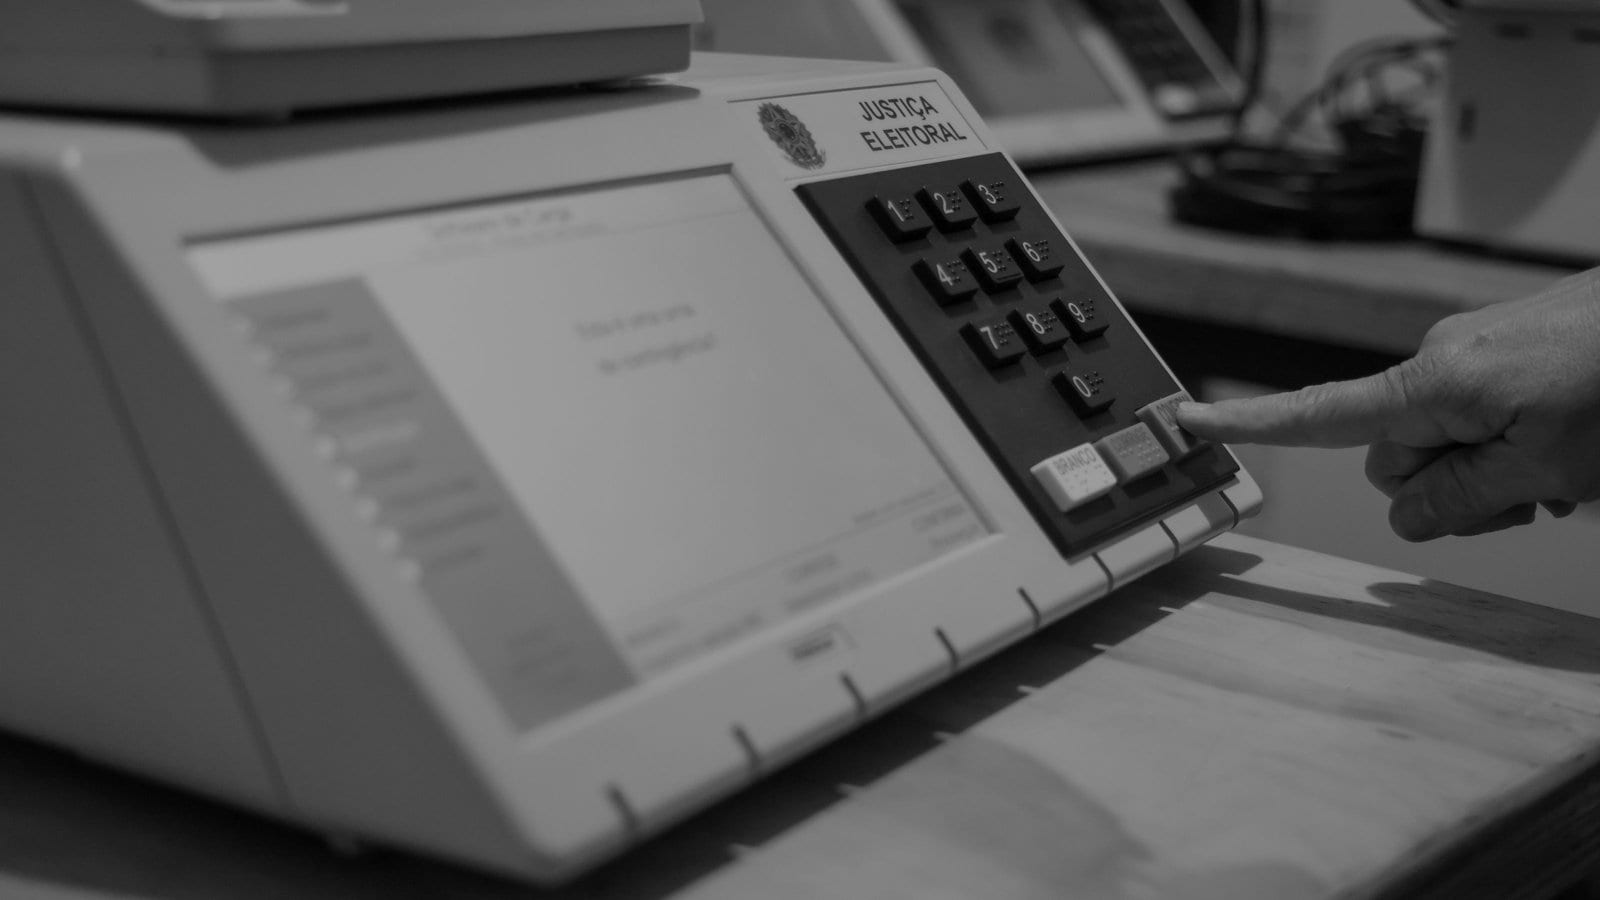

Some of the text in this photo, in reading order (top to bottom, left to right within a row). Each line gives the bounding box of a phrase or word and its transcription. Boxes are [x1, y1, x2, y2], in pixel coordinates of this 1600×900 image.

[858, 96, 939, 121] JUSTIÇA
[859, 122, 967, 152] ELEITORAL
[887, 183, 997, 222] 1 2 3
[936, 241, 1041, 286] 4 5 6
[979, 301, 1086, 350] 7 8 9
[1072, 375, 1092, 398] 0
[1053, 447, 1096, 475] BRANCO
